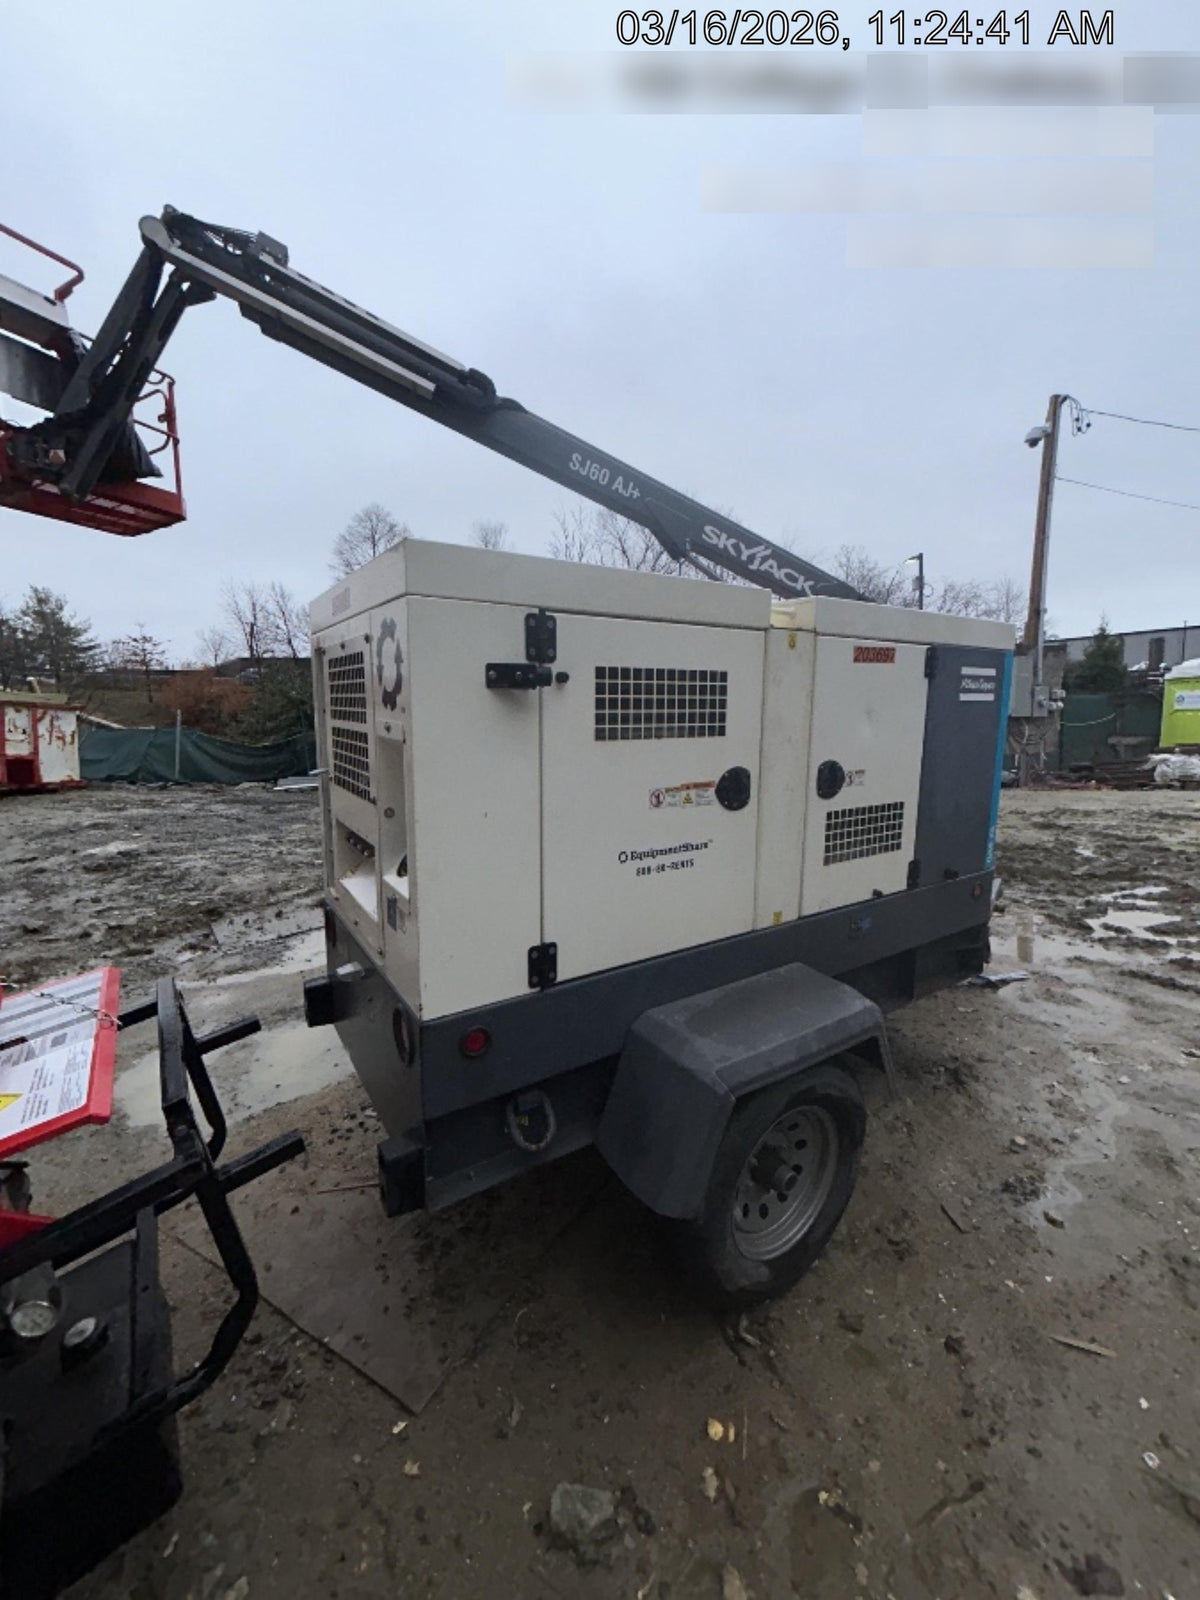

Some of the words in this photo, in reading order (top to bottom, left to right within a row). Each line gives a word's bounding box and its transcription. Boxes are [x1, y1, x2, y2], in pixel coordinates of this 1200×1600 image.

[569, 452, 610, 486] SJ60
[611, 475, 641, 499] AJ+
[701, 524, 816, 598] SKYJACK
